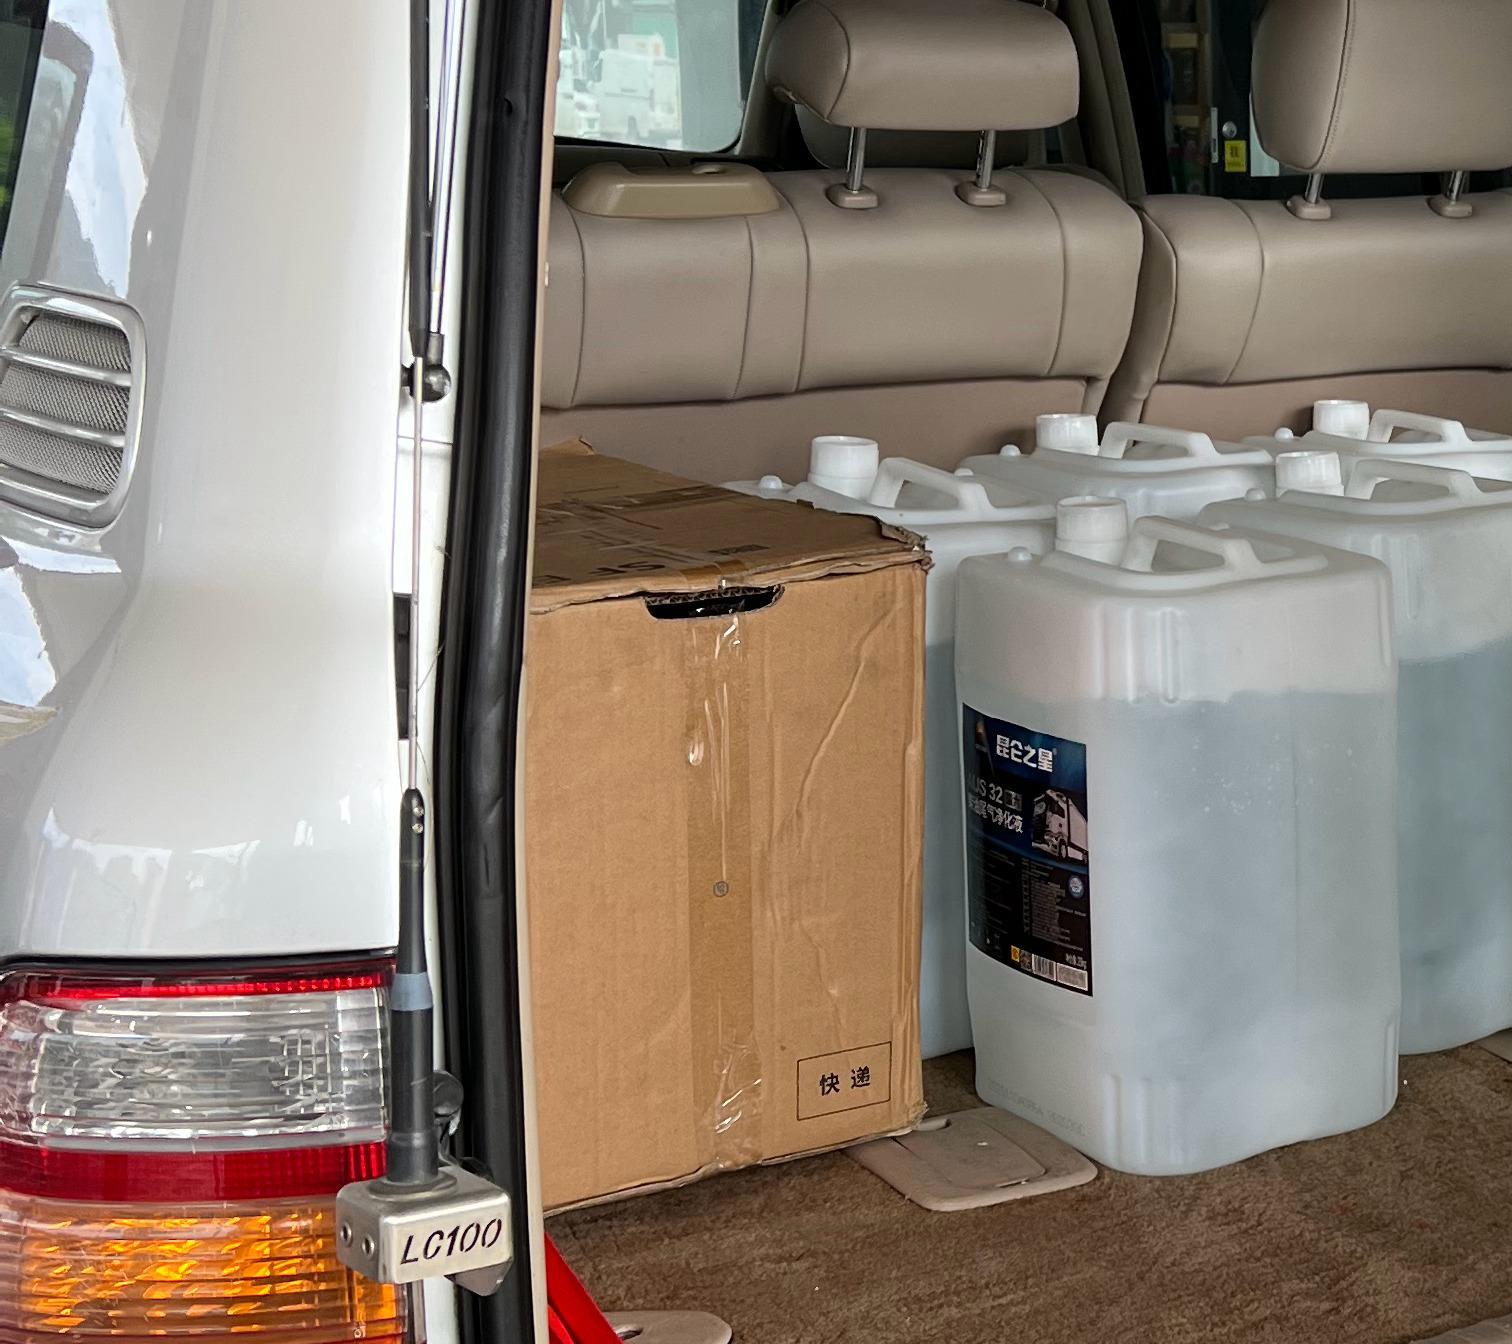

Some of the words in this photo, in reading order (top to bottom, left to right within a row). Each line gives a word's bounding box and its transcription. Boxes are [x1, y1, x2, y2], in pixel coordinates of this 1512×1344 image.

[996, 734, 1053, 773] 昆仑之星
[988, 783, 1003, 804] 32
[819, 1065, 871, 1097] 快递
[400, 1218, 503, 1266] LC100
